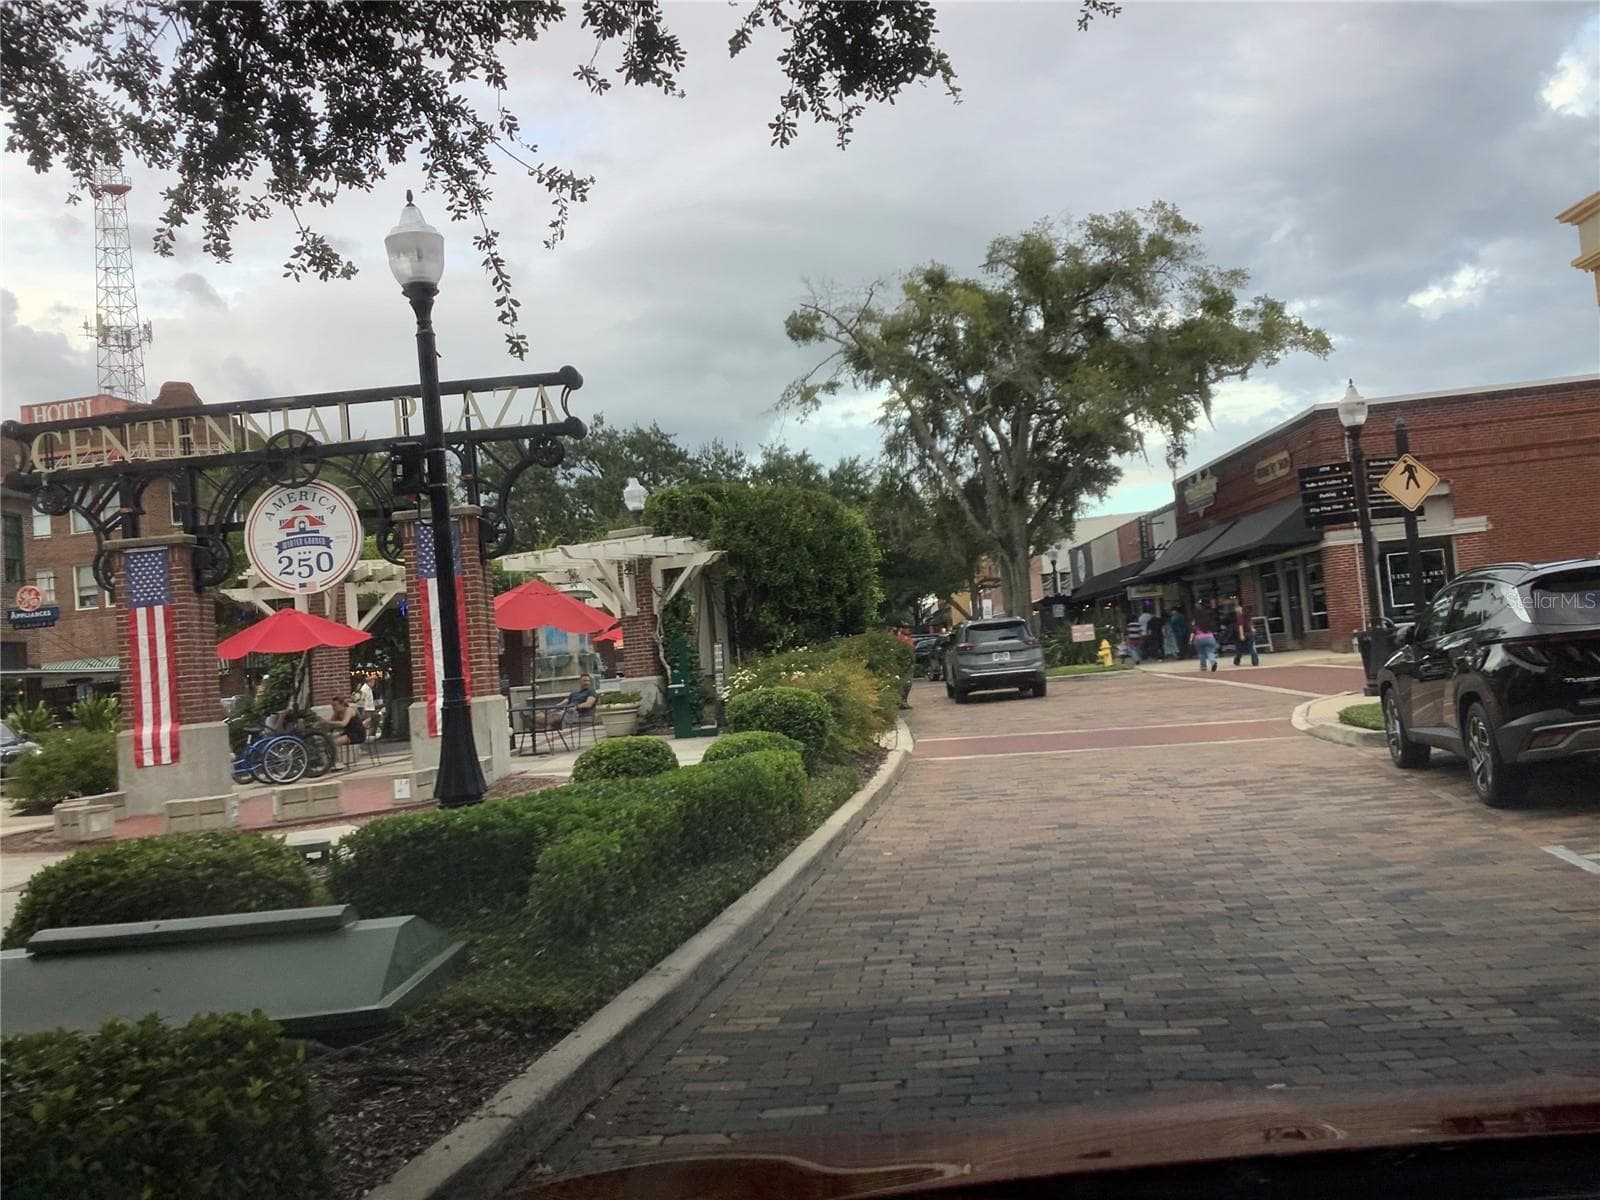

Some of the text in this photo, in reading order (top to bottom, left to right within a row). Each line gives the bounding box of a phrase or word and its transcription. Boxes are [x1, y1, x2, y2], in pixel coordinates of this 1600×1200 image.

[32, 384, 561, 473] CENTENNIAL PAZA
[264, 490, 338, 521] AMERICA
[278, 551, 334, 579] 250
